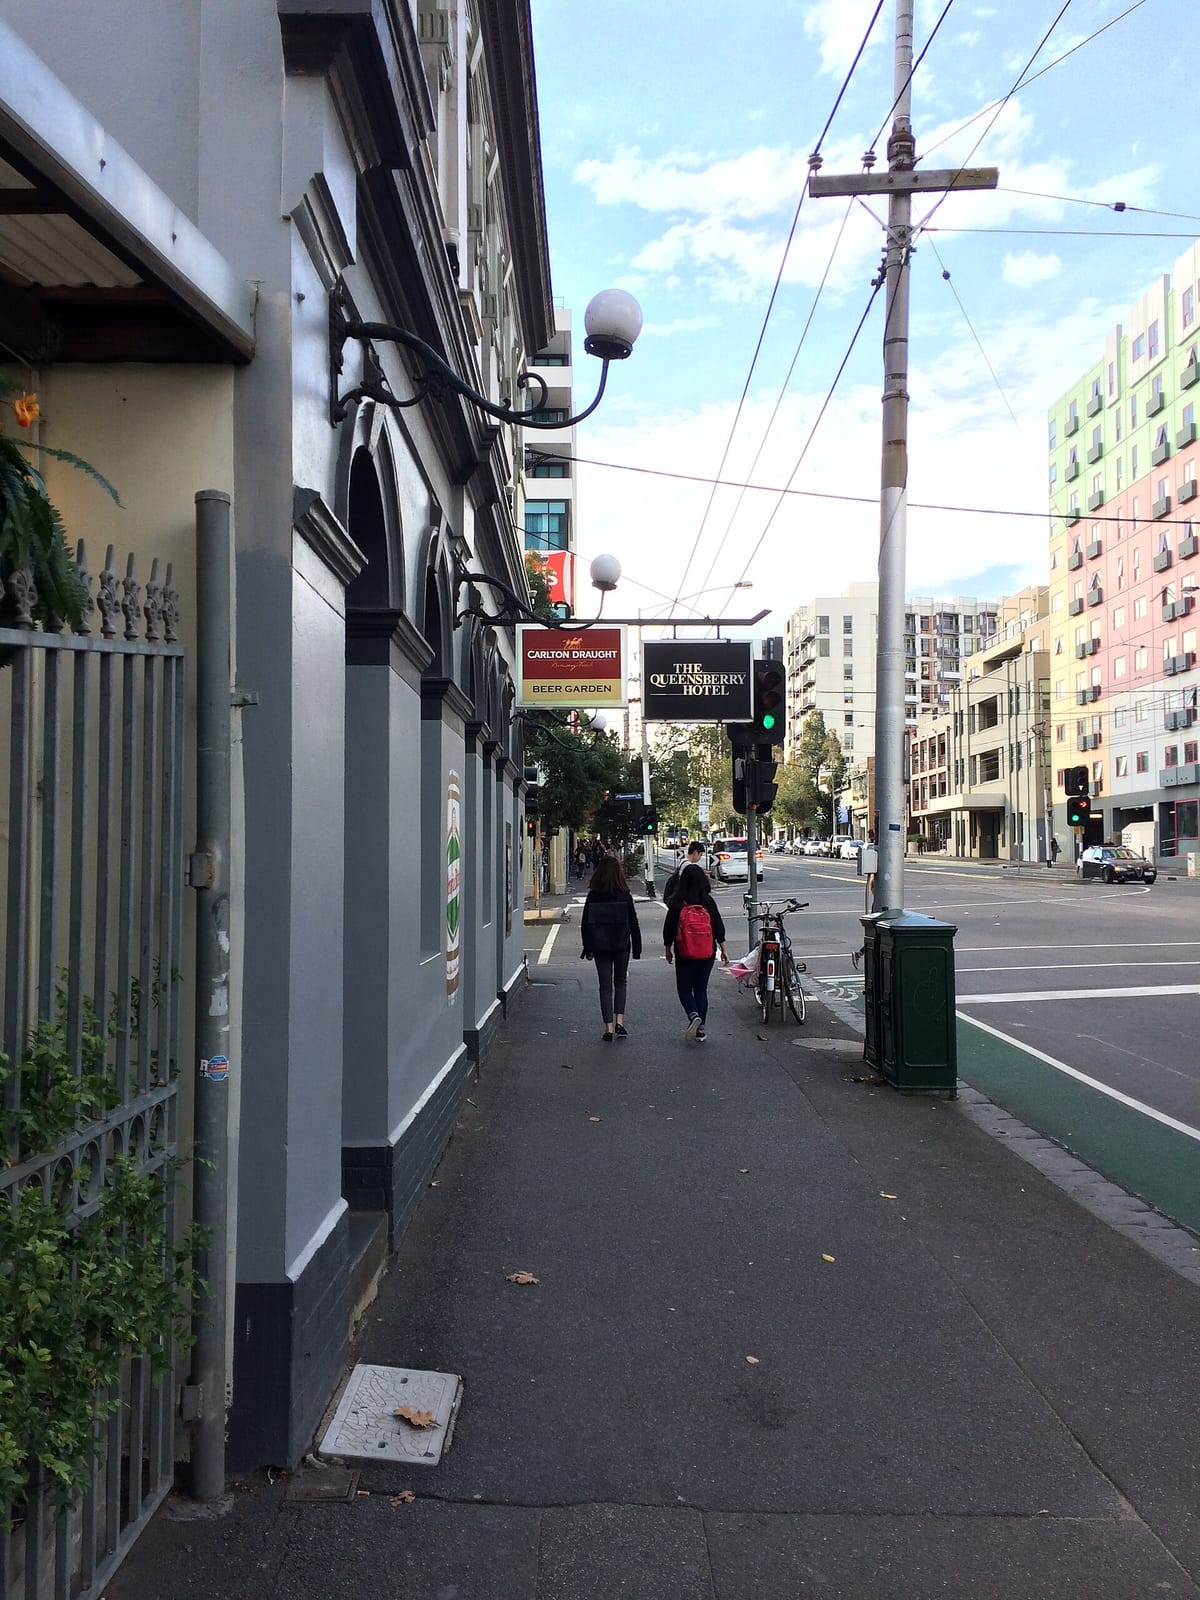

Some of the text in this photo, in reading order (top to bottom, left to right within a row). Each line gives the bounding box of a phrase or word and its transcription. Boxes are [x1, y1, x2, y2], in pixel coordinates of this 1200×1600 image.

[527, 650, 617, 659] CARLTON DRAUGHT
[673, 663, 703, 674] THE
[650, 673, 747, 688] QUEENSBERRY
[532, 685, 612, 693] BEER GARDEN
[683, 684, 730, 696] HOTEL
